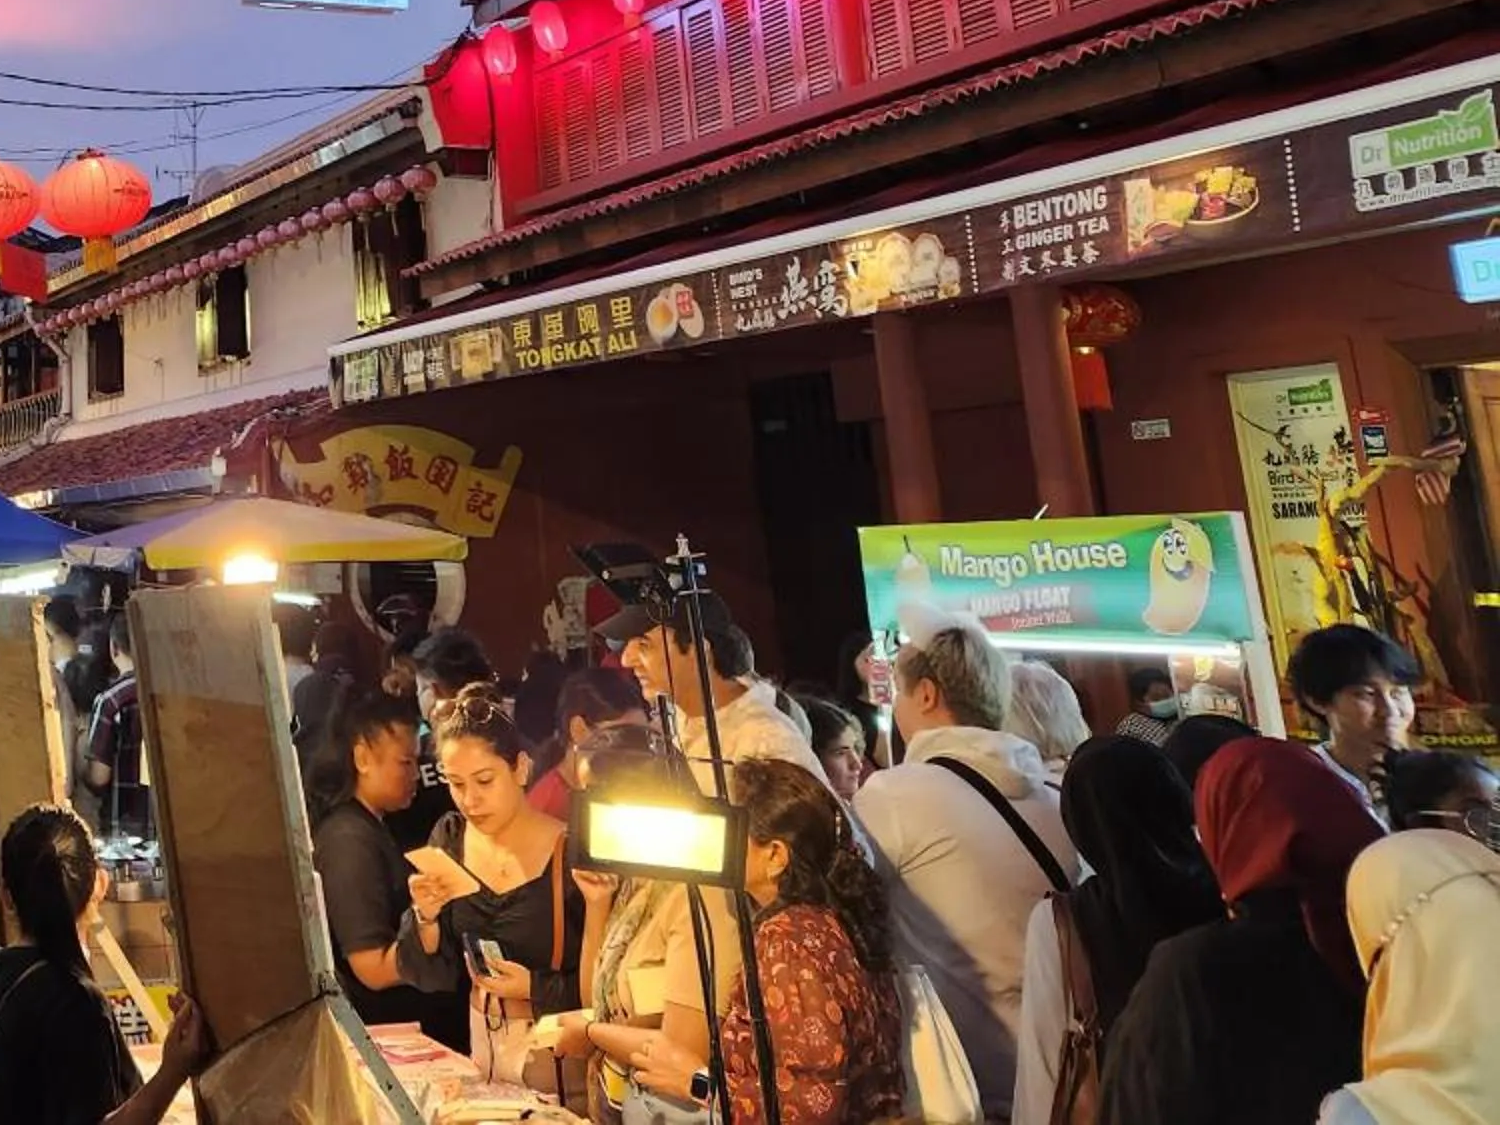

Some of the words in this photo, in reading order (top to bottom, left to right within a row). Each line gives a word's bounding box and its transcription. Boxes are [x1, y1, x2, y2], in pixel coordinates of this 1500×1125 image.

[1360, 144, 1383, 164] Dr
[1393, 124, 1483, 156] Nutrition
[1013, 185, 1108, 229] BENTONG
[1015, 226, 1075, 252] GINGER
[1077, 216, 1110, 236] TEA
[730, 285, 758, 301] NEST
[516, 339, 603, 371] TONGKAT
[606, 329, 638, 356] ALI
[939, 545, 1029, 588] Mango
[1029, 540, 1128, 574] House
[1023, 586, 1072, 610] FLOAT
